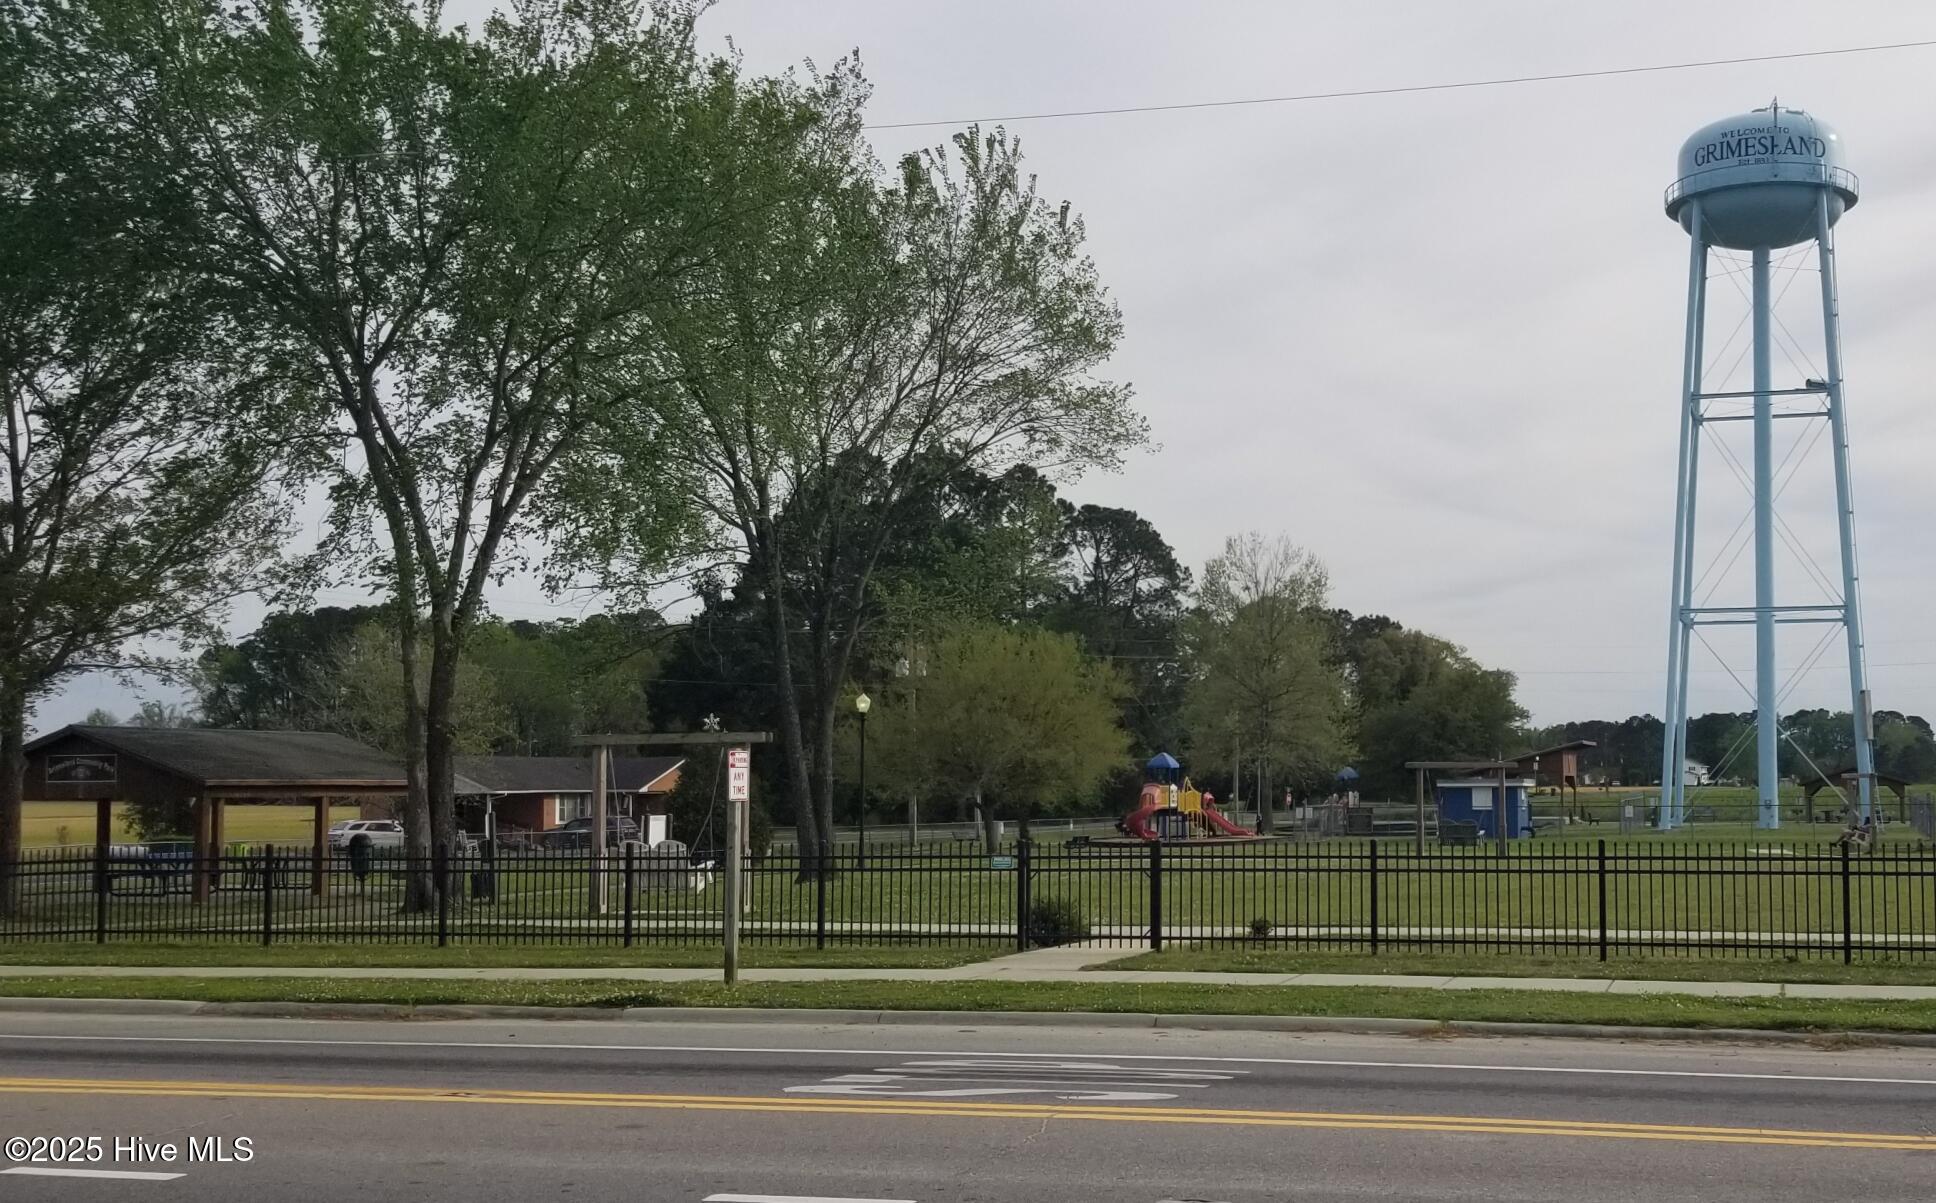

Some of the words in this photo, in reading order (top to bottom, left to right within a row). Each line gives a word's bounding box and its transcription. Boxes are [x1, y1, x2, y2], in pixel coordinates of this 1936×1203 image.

[1720, 127, 1773, 139] WELCOME
[1778, 126, 1790, 134] TO
[1694, 135, 1826, 166] GRIMESLAND
[733, 772, 744, 782] ANY
[733, 785, 745, 795] TIME
[783, 1059, 1251, 1101] STOP
